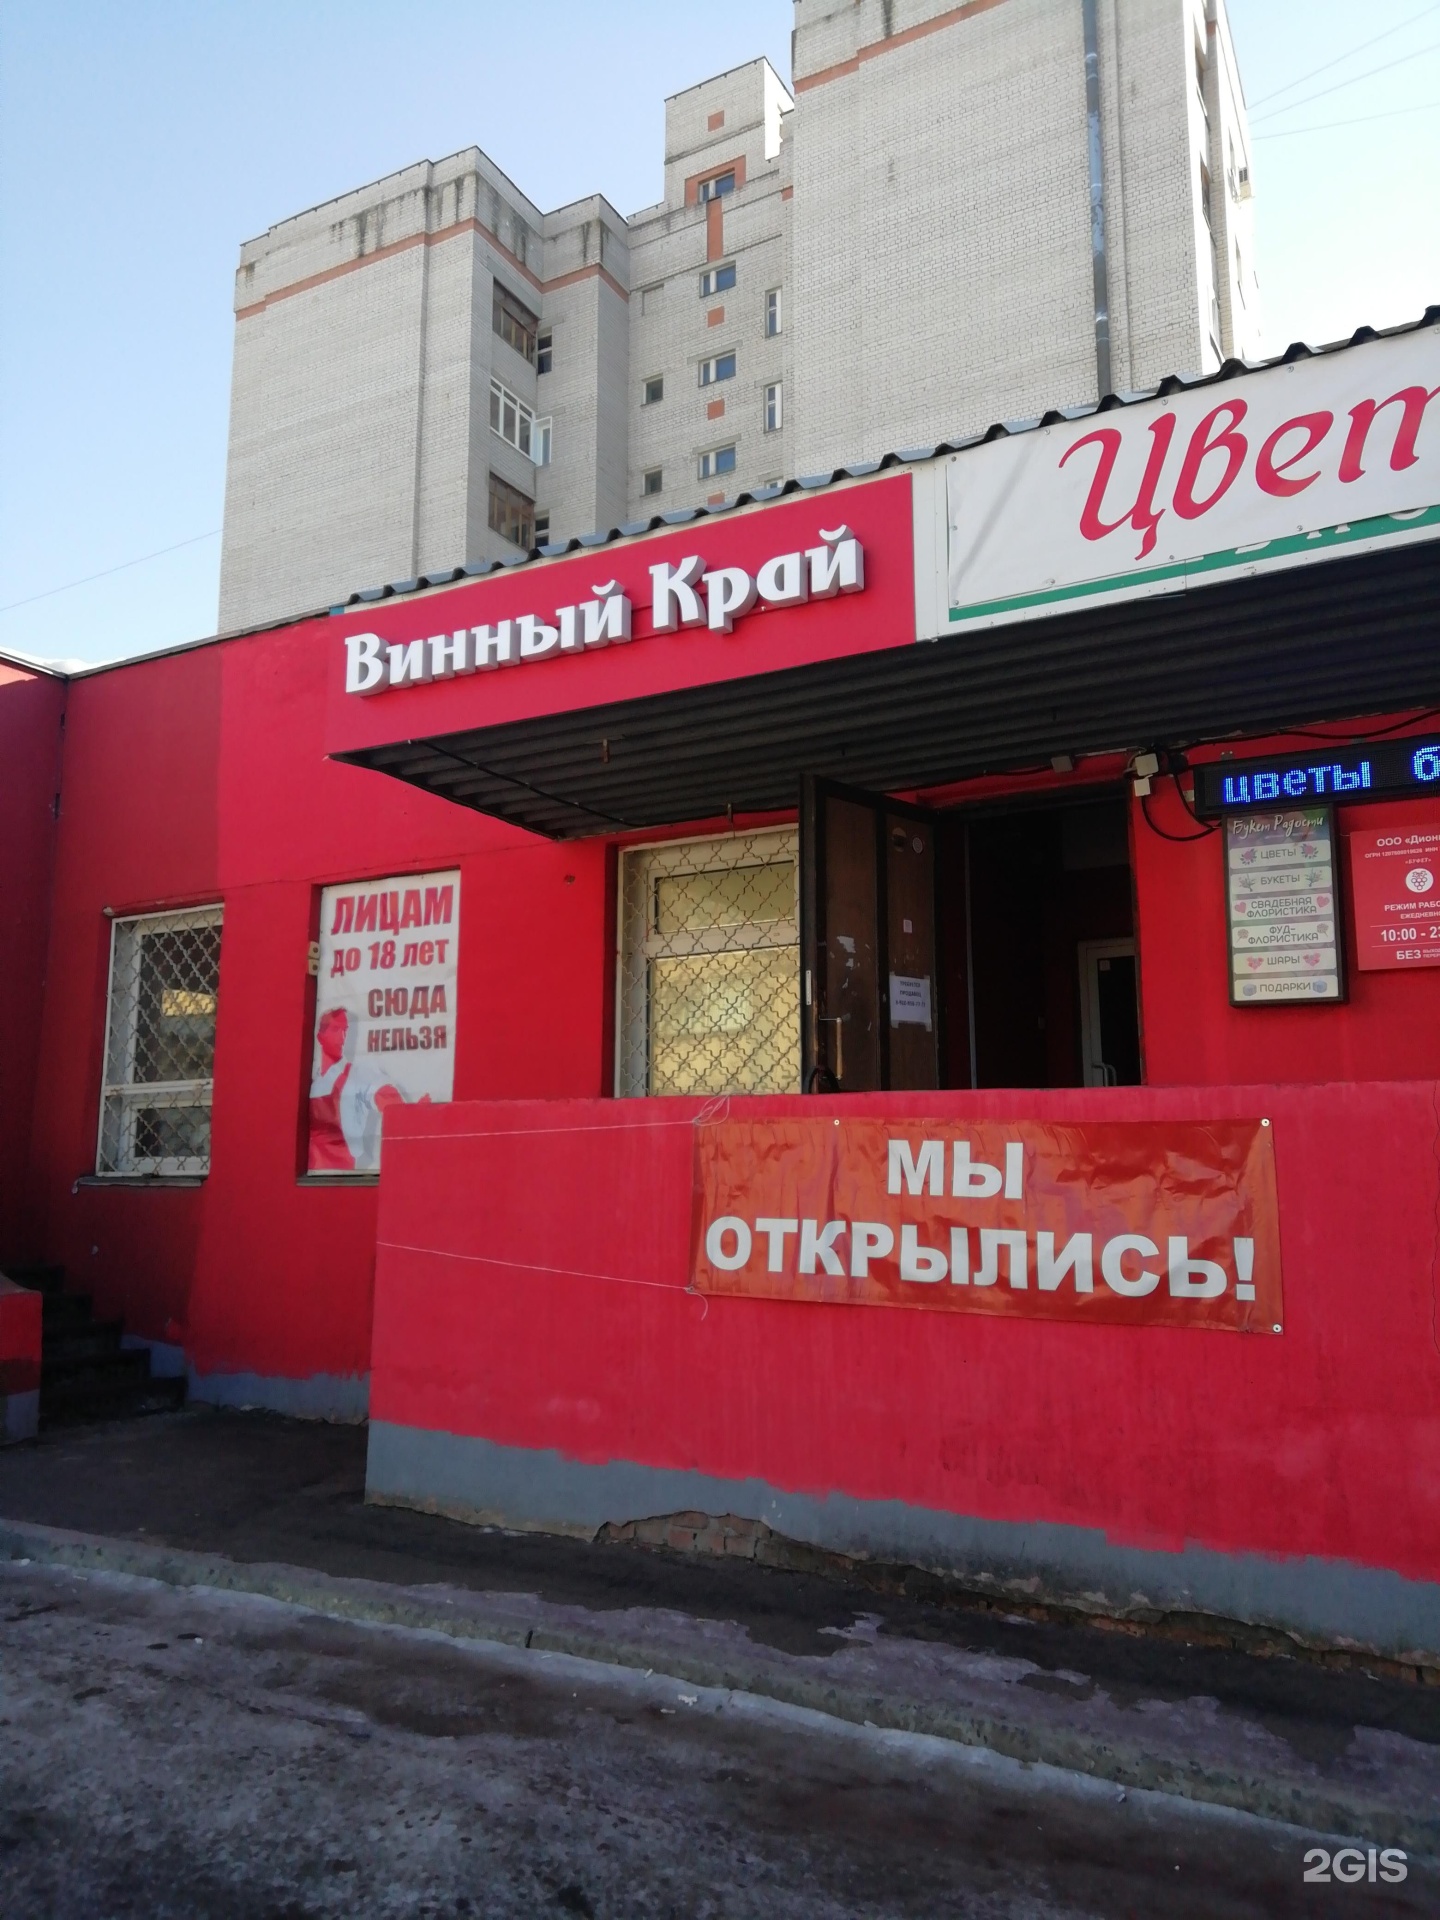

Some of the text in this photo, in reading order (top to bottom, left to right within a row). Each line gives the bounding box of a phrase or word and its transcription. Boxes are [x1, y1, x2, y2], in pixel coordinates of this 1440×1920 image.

[344, 524, 864, 696] Винный Край
[1233, 820, 1270, 839] Букет
[1273, 814, 1324, 837] Радости
[1377, 837, 1402, 847] ООО
[1261, 848, 1297, 859] ЦВЕТЫ
[1261, 875, 1300, 886] БУКЕТЫ
[1251, 897, 1312, 909] СВАДЕБНАЯ
[1384, 902, 1417, 912] РЕЖИМ
[331, 885, 454, 936] ЛИЦАМ
[1247, 906, 1318, 918] ФЛОРИСТИКА
[1269, 925, 1296, 935] ФУД-
[1381, 927, 1417, 942] 10:00
[1248, 933, 1319, 945] ФЛОРИСТИКА
[330, 938, 449, 978] до 18 лет
[1267, 955, 1300, 965] ШАРЫ
[1396, 949, 1422, 960] БЕЗ
[1259, 982, 1311, 993] ПОДАРКИ
[368, 984, 447, 1020] СЮДА
[367, 1025, 447, 1053] НЕЛЬЗЯ
[887, 1138, 1024, 1200] МЫ
[705, 1216, 1256, 1301] ОТКРЫЛИСЬ!
